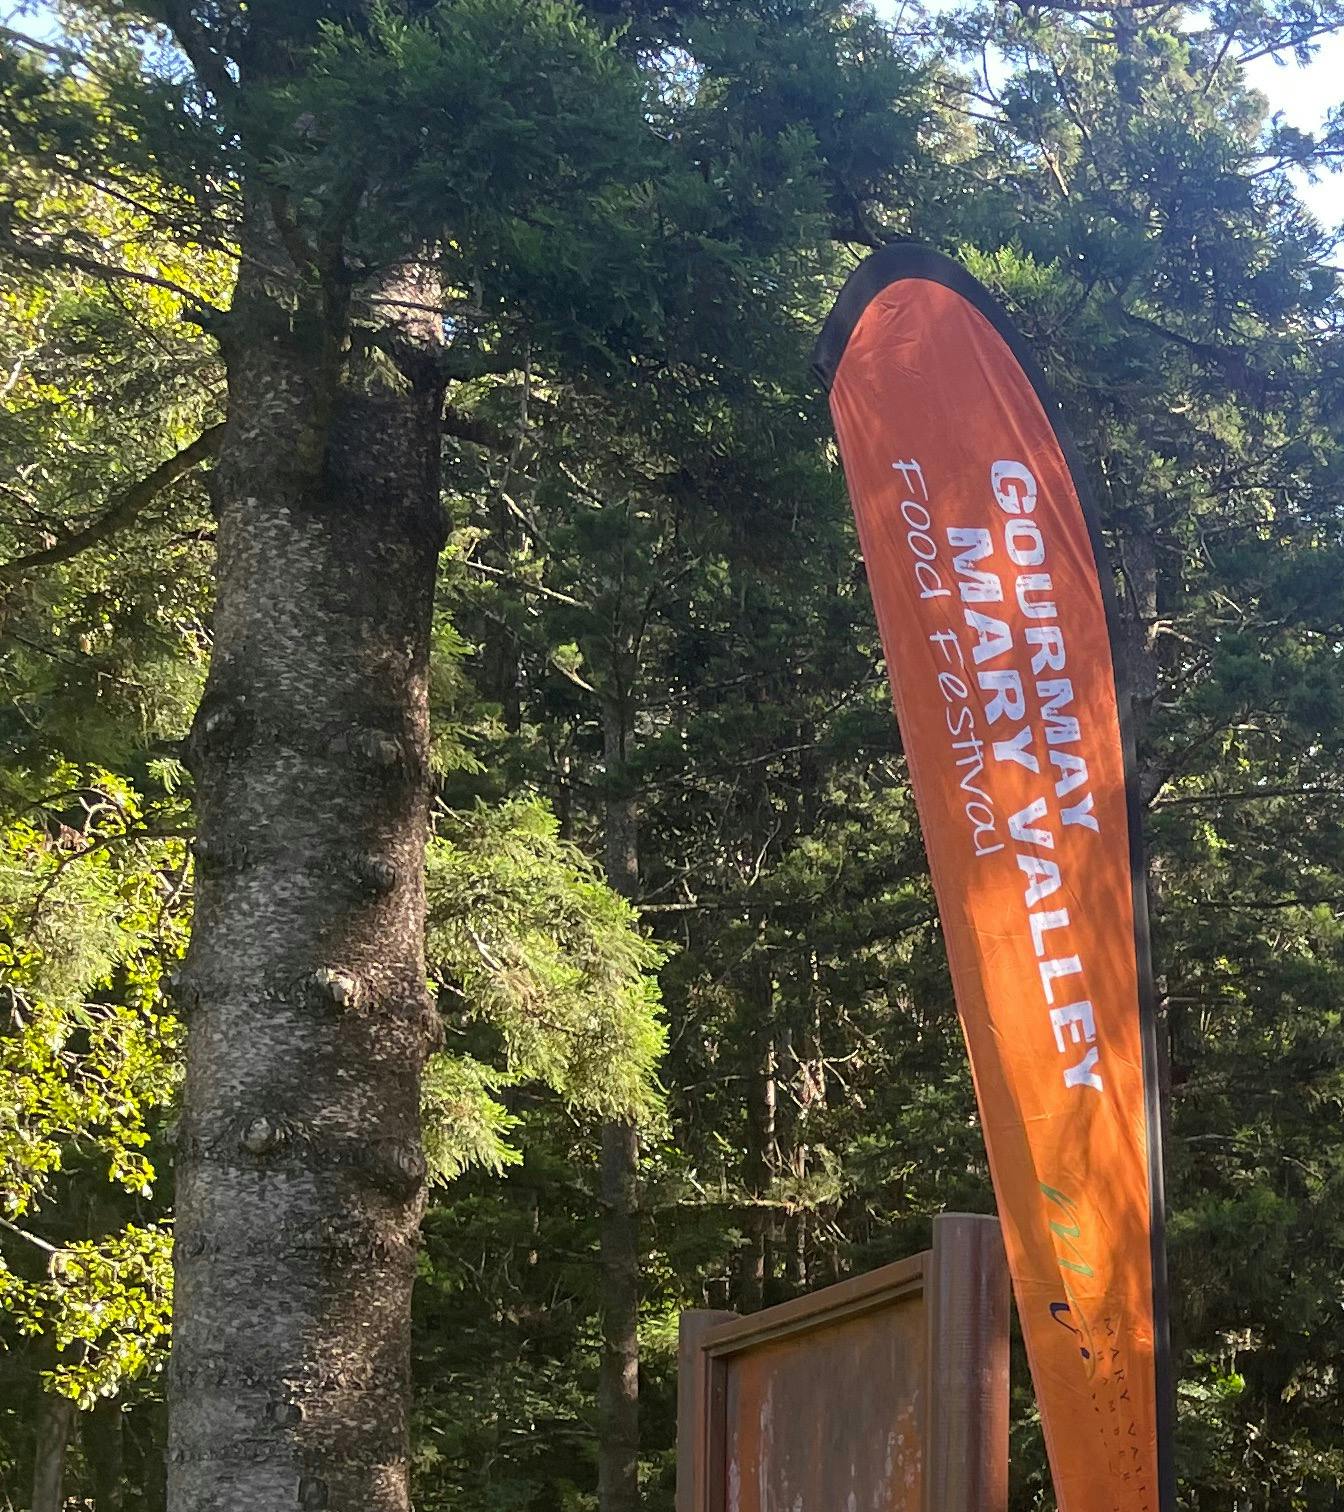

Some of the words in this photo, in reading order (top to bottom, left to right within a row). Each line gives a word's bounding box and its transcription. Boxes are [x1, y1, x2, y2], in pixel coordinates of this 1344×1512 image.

[945, 526, 1040, 774] MARY
[1008, 796, 1104, 1093] VALLEY
[990, 459, 1101, 834] GOURMAY
[1103, 1316, 1131, 1402] MARY
